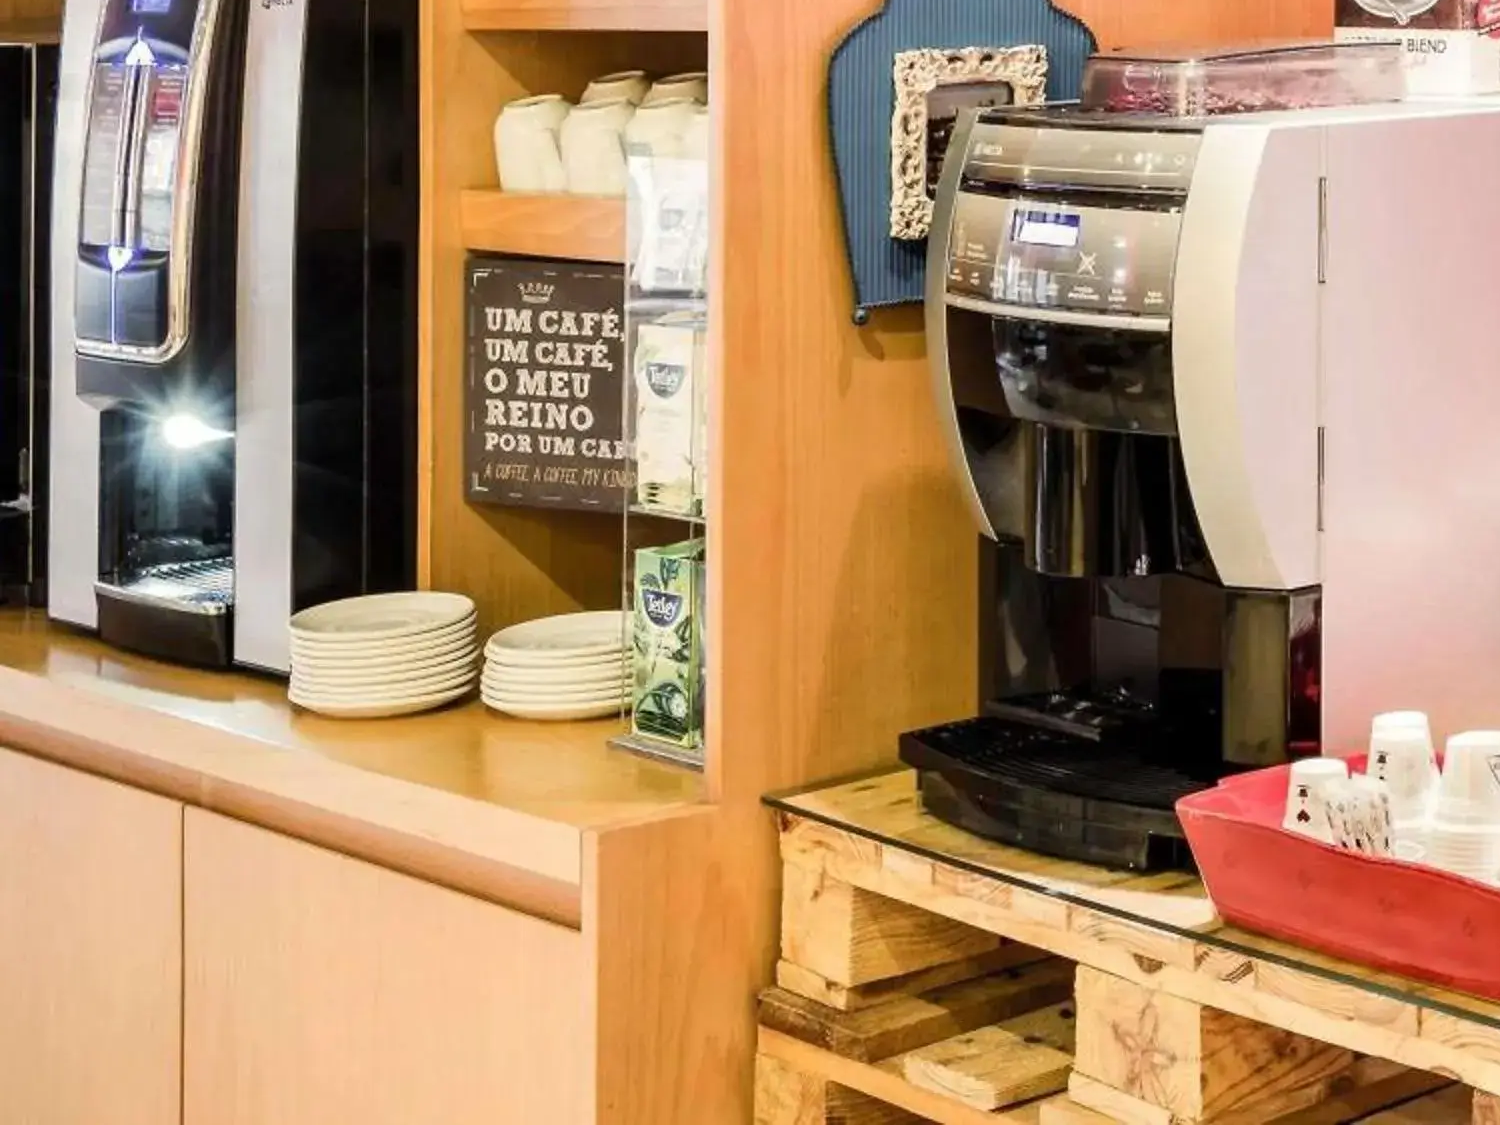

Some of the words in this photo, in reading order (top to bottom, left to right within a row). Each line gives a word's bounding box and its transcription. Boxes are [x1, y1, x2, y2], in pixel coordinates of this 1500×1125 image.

[1407, 38, 1447, 54] BLEND
[484, 307, 533, 334] UM
[484, 338, 529, 364] UM
[535, 339, 613, 372] CAFÉ,
[484, 367, 508, 393] O
[516, 368, 591, 399] MEU
[485, 398, 594, 432] REINO
[484, 431, 533, 454] POR
[539, 435, 576, 456] UM
